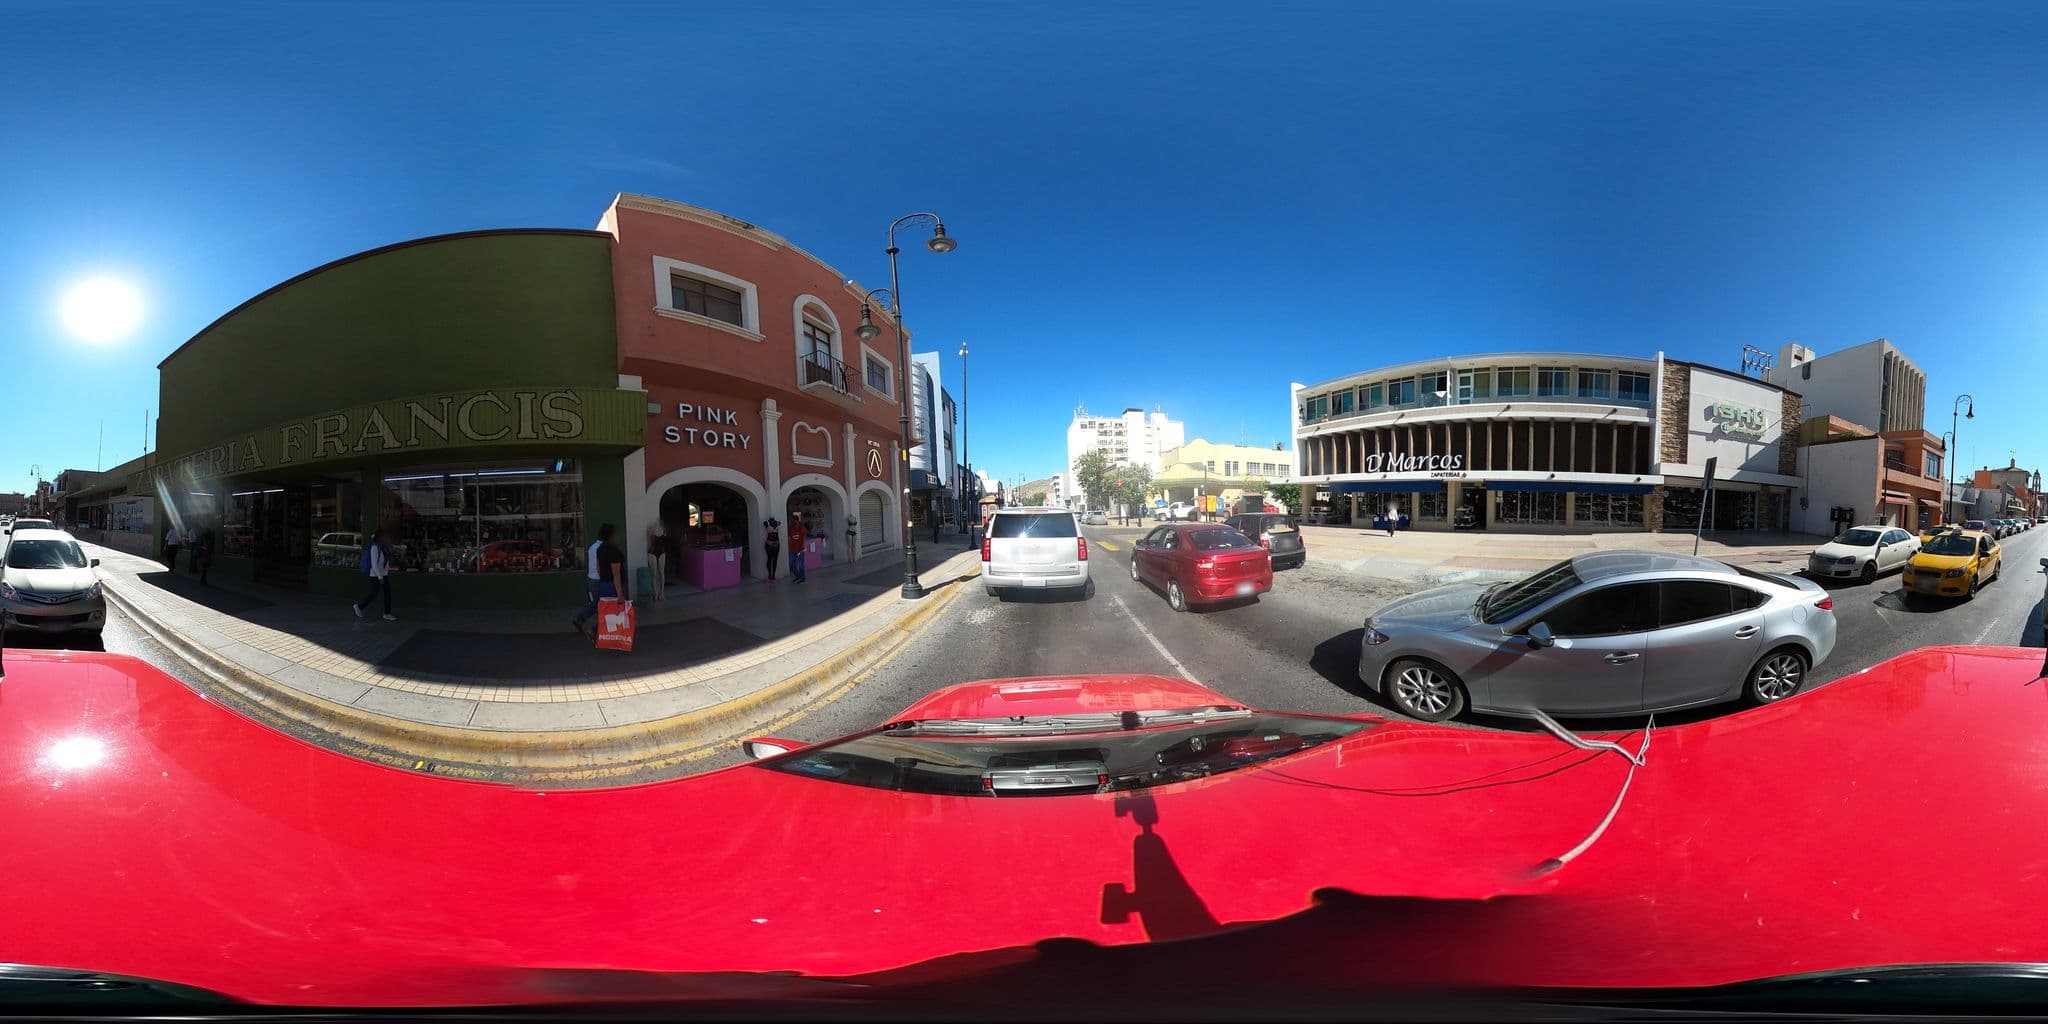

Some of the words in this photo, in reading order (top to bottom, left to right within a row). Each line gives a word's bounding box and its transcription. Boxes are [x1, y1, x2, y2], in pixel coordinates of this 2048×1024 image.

[679, 403, 738, 426] PINK
[279, 389, 584, 464] FRANCIS
[665, 426, 751, 450] STORY
[1366, 452, 1462, 472] D'Marcos
